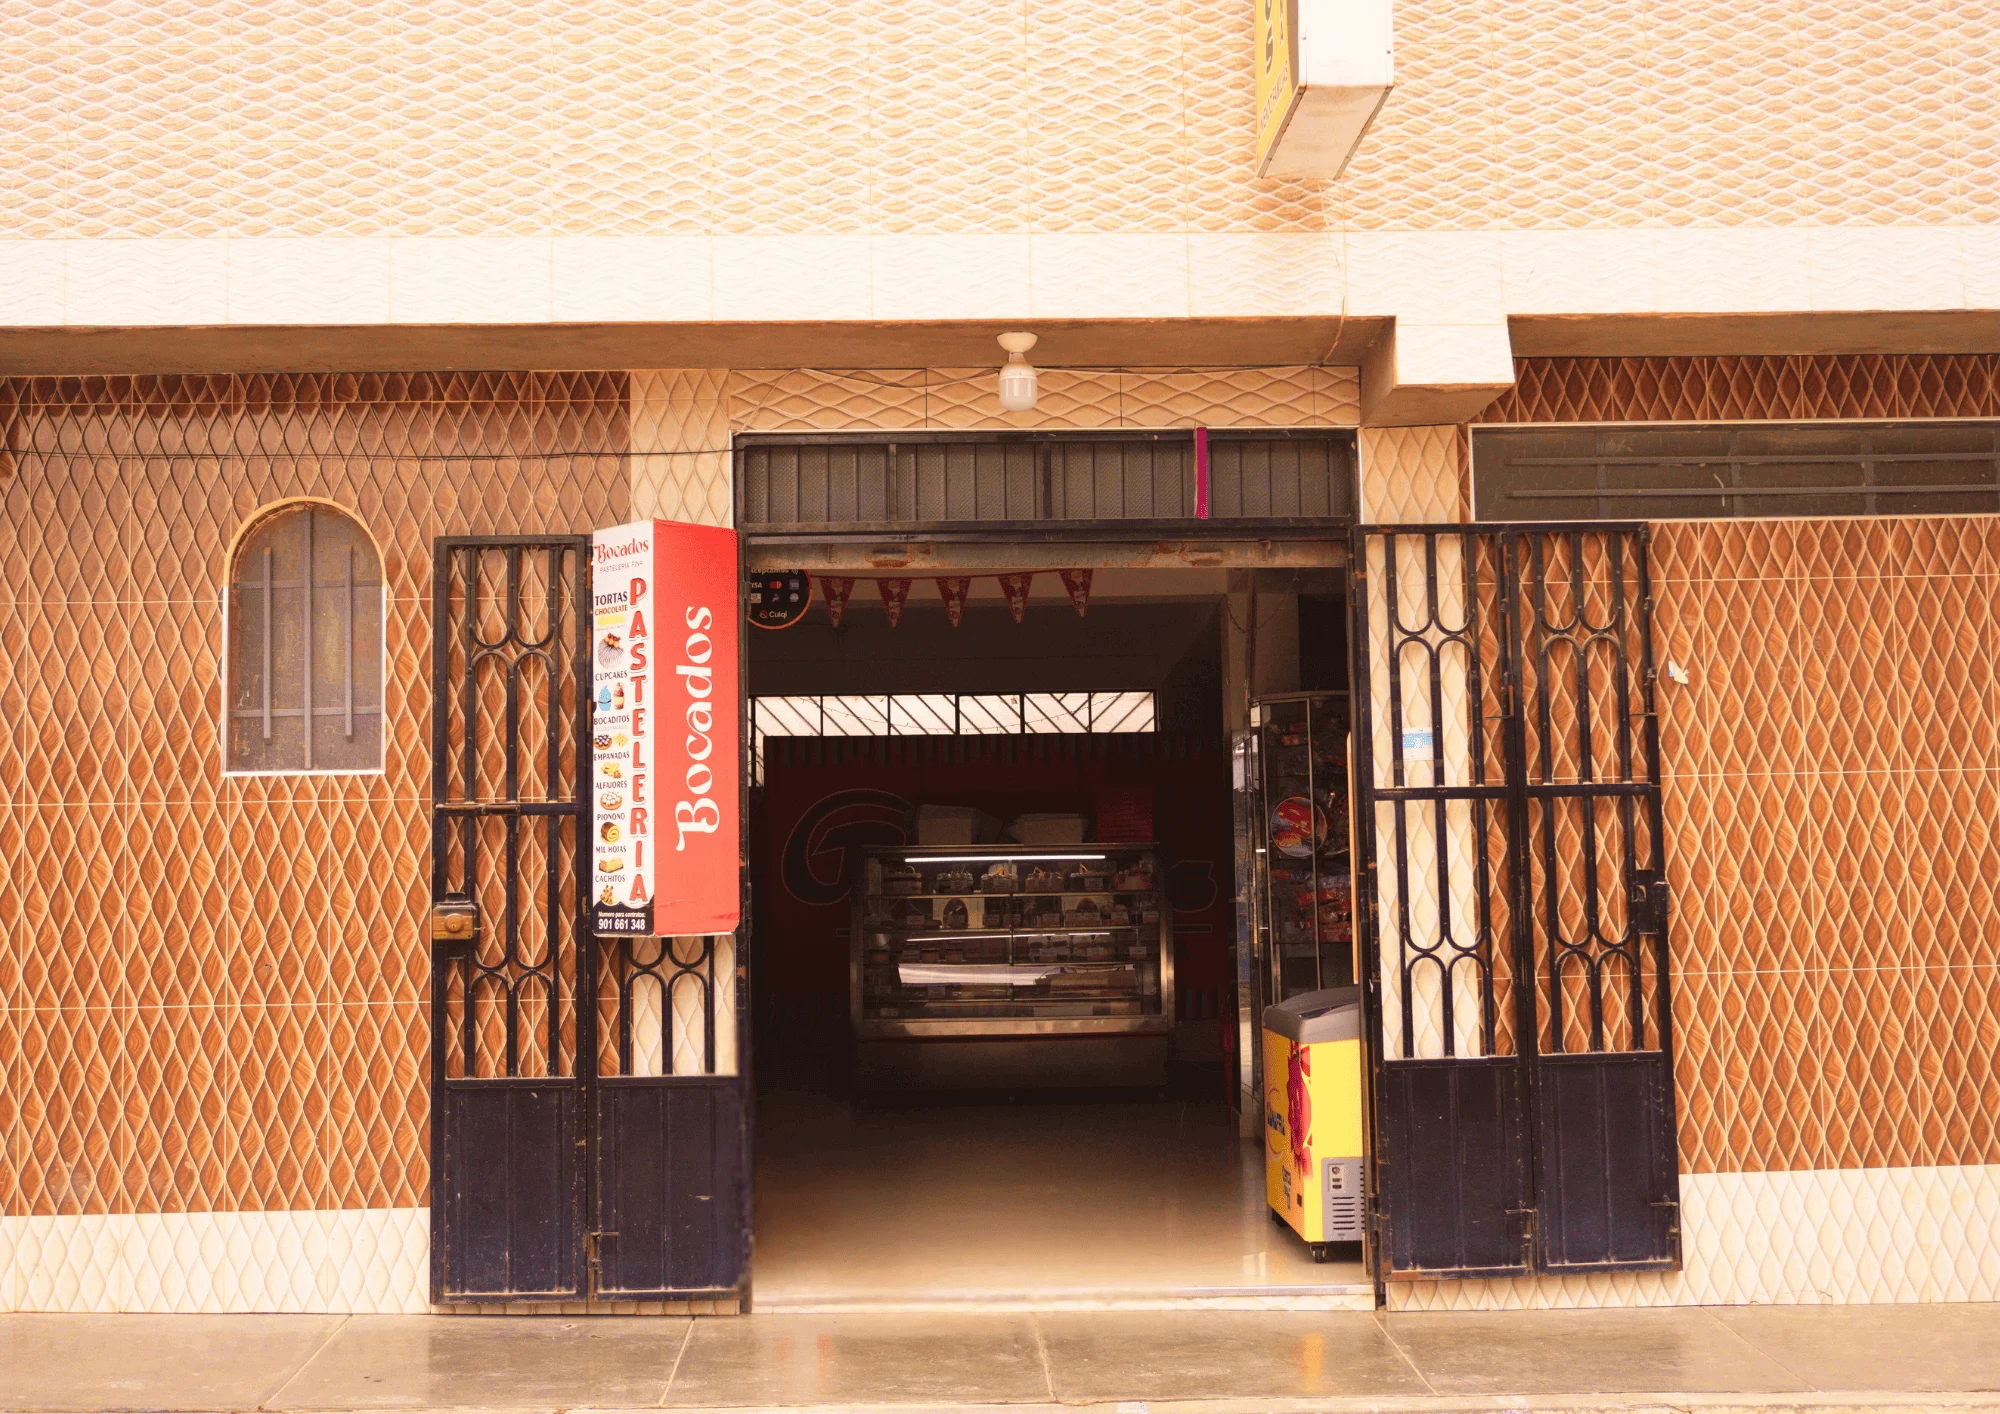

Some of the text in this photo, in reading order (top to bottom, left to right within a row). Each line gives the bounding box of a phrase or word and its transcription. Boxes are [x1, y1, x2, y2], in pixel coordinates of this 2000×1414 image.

[593, 538, 649, 563] Bocados
[595, 591, 628, 606] TORTAS
[595, 604, 628, 616] CHOCOLATE
[769, 611, 788, 619] Culqi
[595, 670, 628, 681] CUPCAKES
[593, 715, 630, 725] BOCADITOS
[675, 606, 720, 852] Bocados
[629, 577, 648, 902] PASTELERIA
[593, 751, 630, 761] EMPANADAS
[595, 780, 628, 789] ALFAJORES
[597, 812, 625, 820] PIONONO
[608, 845, 627, 853] HOJAS
[595, 874, 626, 882] CACHITOS
[598, 918, 646, 930] 901 661 348
